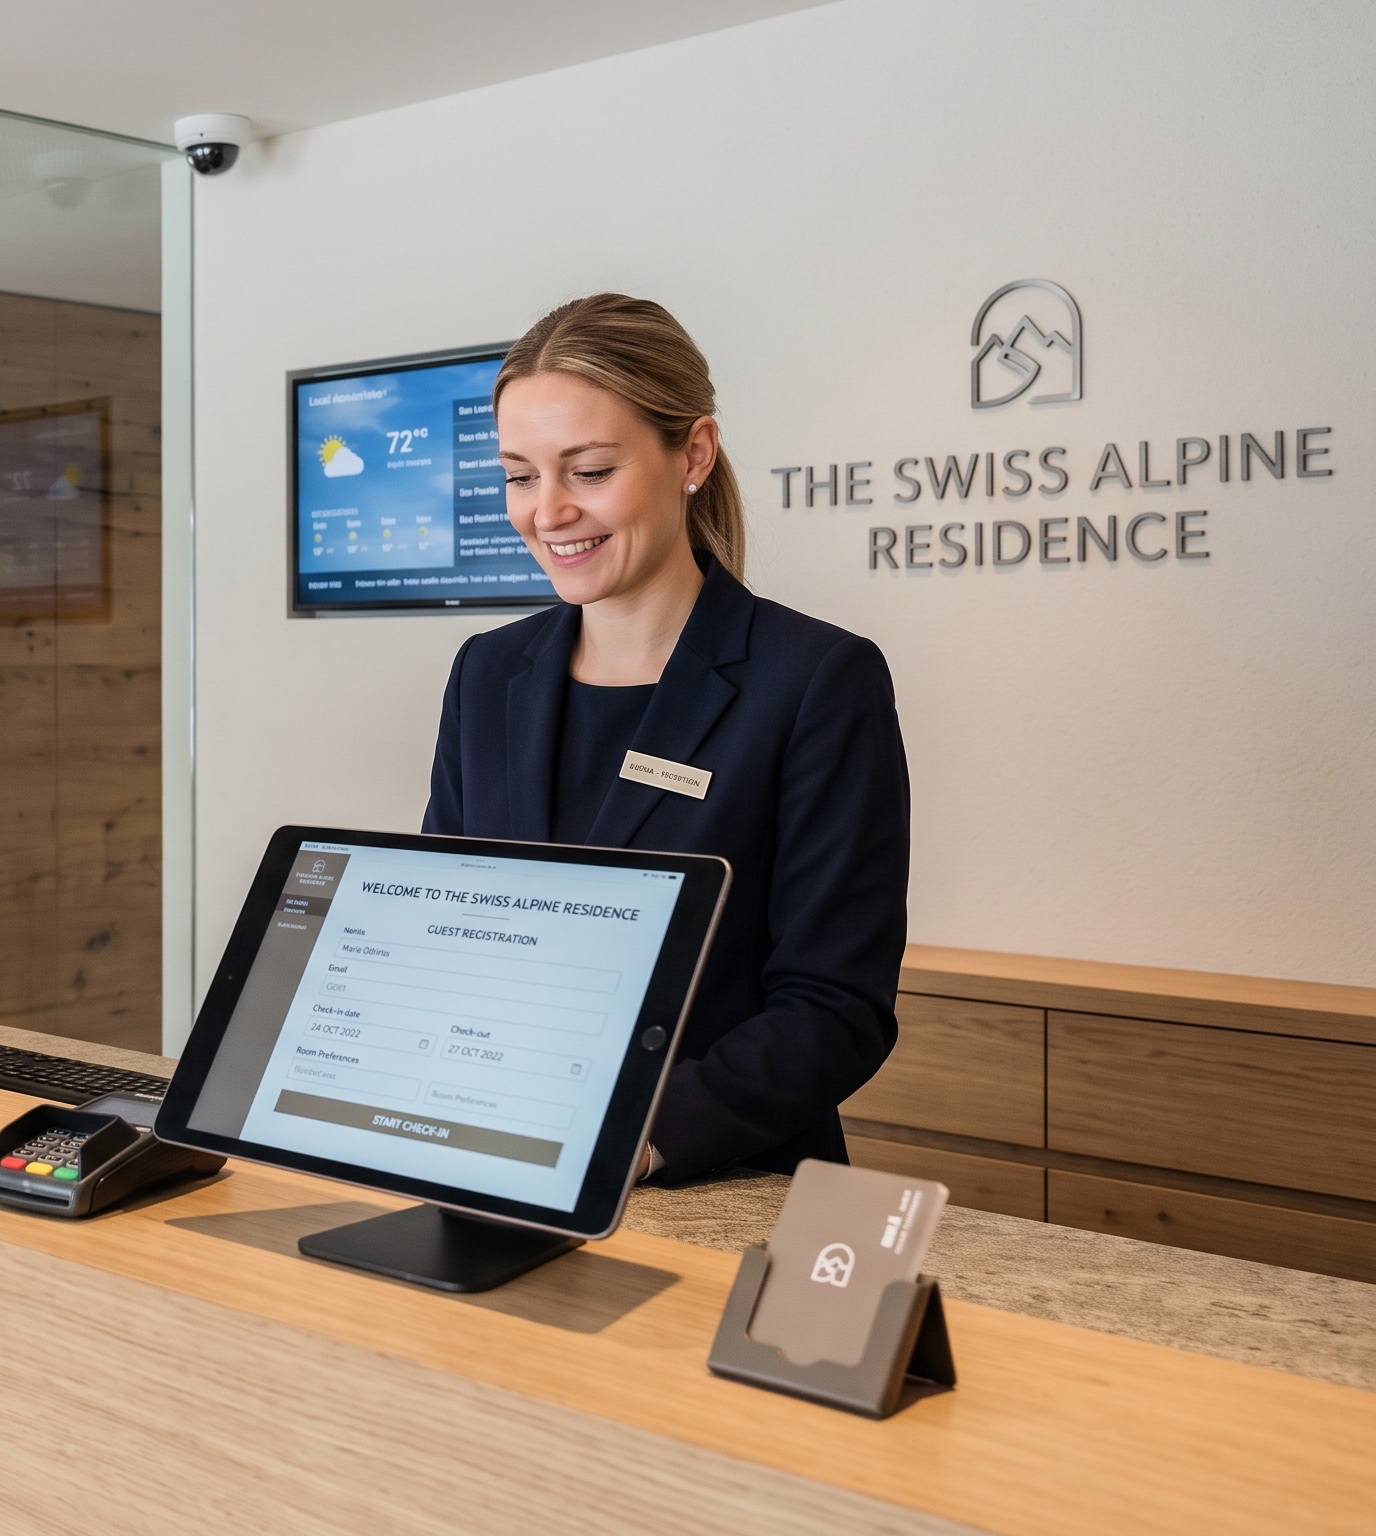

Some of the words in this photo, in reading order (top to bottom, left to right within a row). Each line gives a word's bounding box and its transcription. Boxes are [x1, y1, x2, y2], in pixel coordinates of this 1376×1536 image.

[770, 461, 873, 509] THE
[892, 445, 1069, 503] SWISS
[1089, 426, 1334, 491] ALPINE
[868, 510, 1210, 570] RESIDENCE
[362, 881, 422, 899] WELCOME
[425, 887, 441, 900] TO
[445, 890, 468, 903] THE
[471, 893, 510, 908] SWISS
[512, 897, 561, 913] ALPINE
[563, 903, 640, 922] RESIDENCE
[344, 1009, 361, 1018] date
[311, 1022, 322, 1032] 24
[322, 1024, 340, 1034] OCT
[340, 1027, 361, 1038] 2022
[296, 1046, 317, 1056] Room
[318, 1049, 360, 1064] Preferences
[448, 1044, 461, 1054] 27
[461, 1046, 481, 1057] OCT
[481, 1049, 504, 1061] 2022
[372, 1115, 403, 1129] START
[402, 1120, 451, 1139] CHECK-IN
